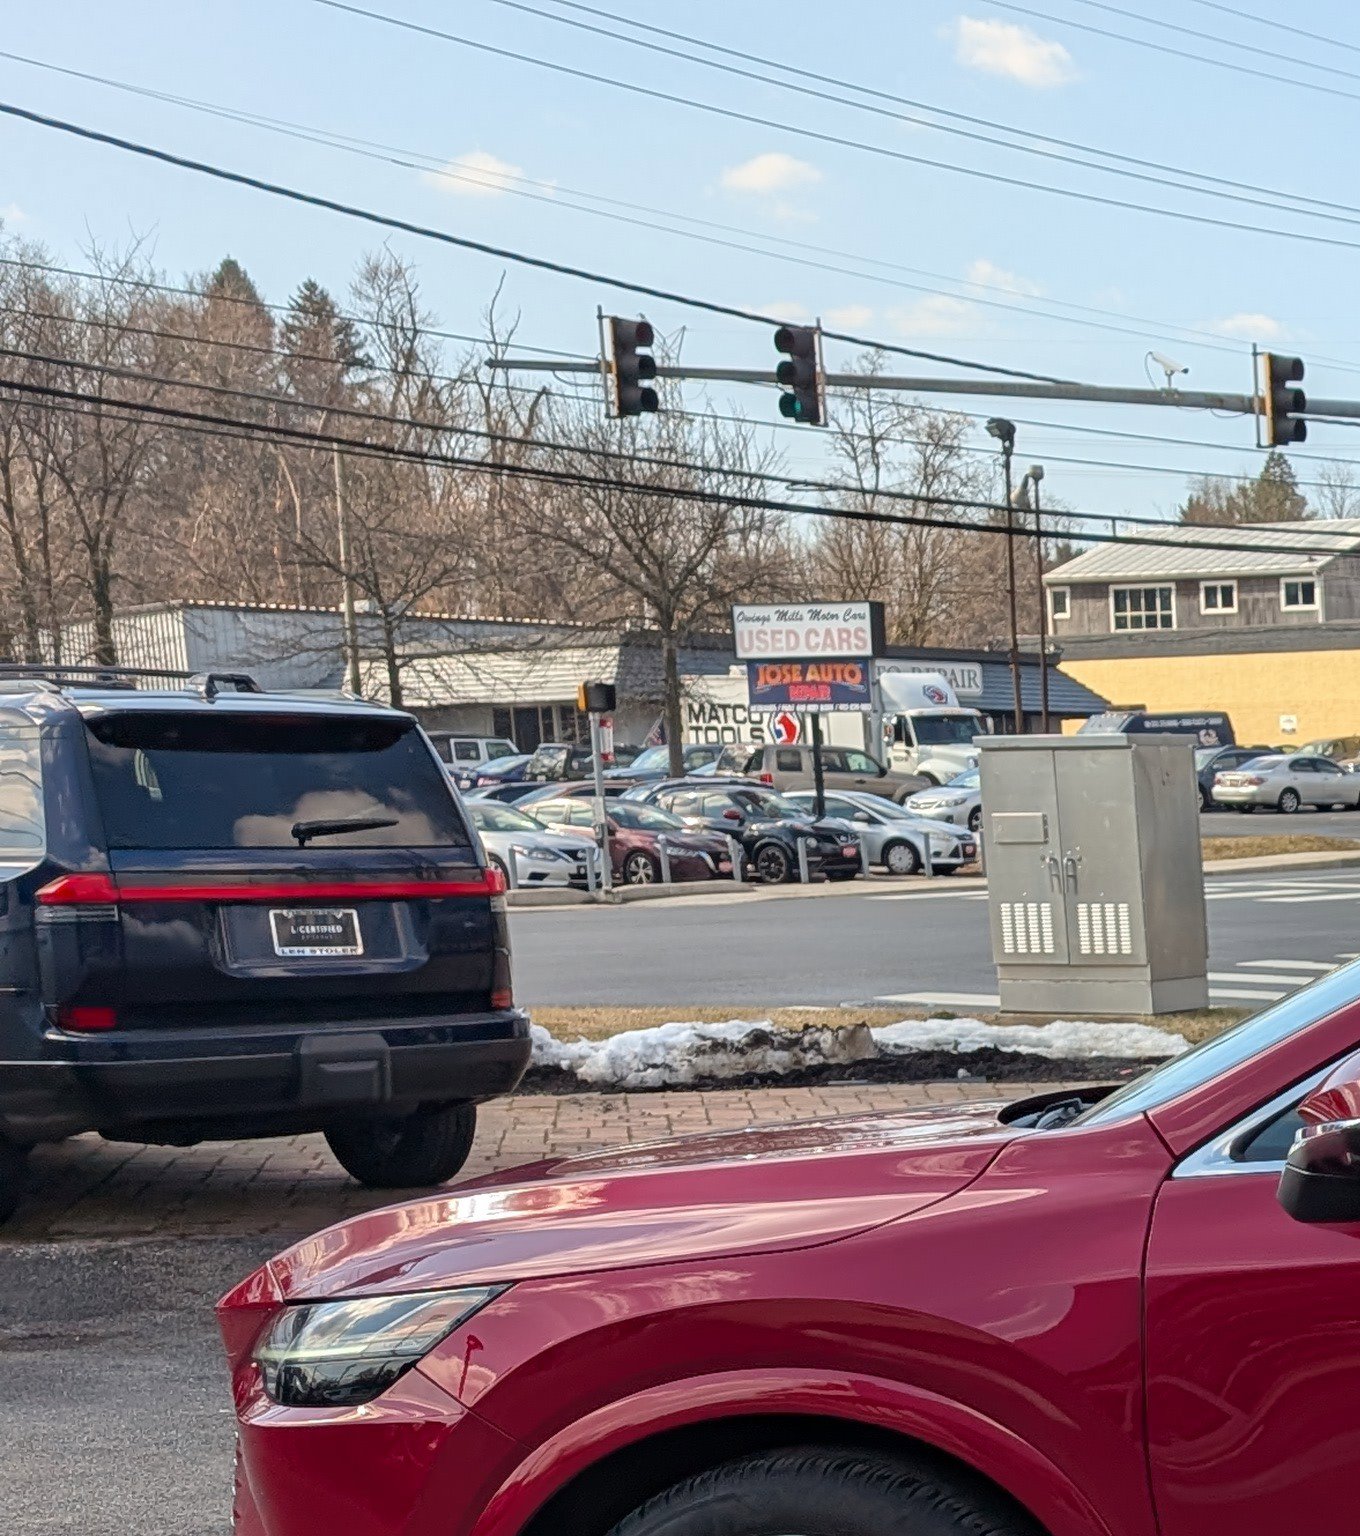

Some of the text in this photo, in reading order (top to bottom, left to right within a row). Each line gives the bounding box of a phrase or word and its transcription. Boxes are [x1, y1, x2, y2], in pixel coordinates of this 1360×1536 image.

[736, 607, 866, 625] Owings Mills Motor Cars
[738, 626, 868, 652] USED CARS
[756, 663, 802, 687] JOSE
[806, 663, 862, 685] AUTO
[688, 703, 763, 724] MATCO
[689, 726, 764, 744] TOOLS
